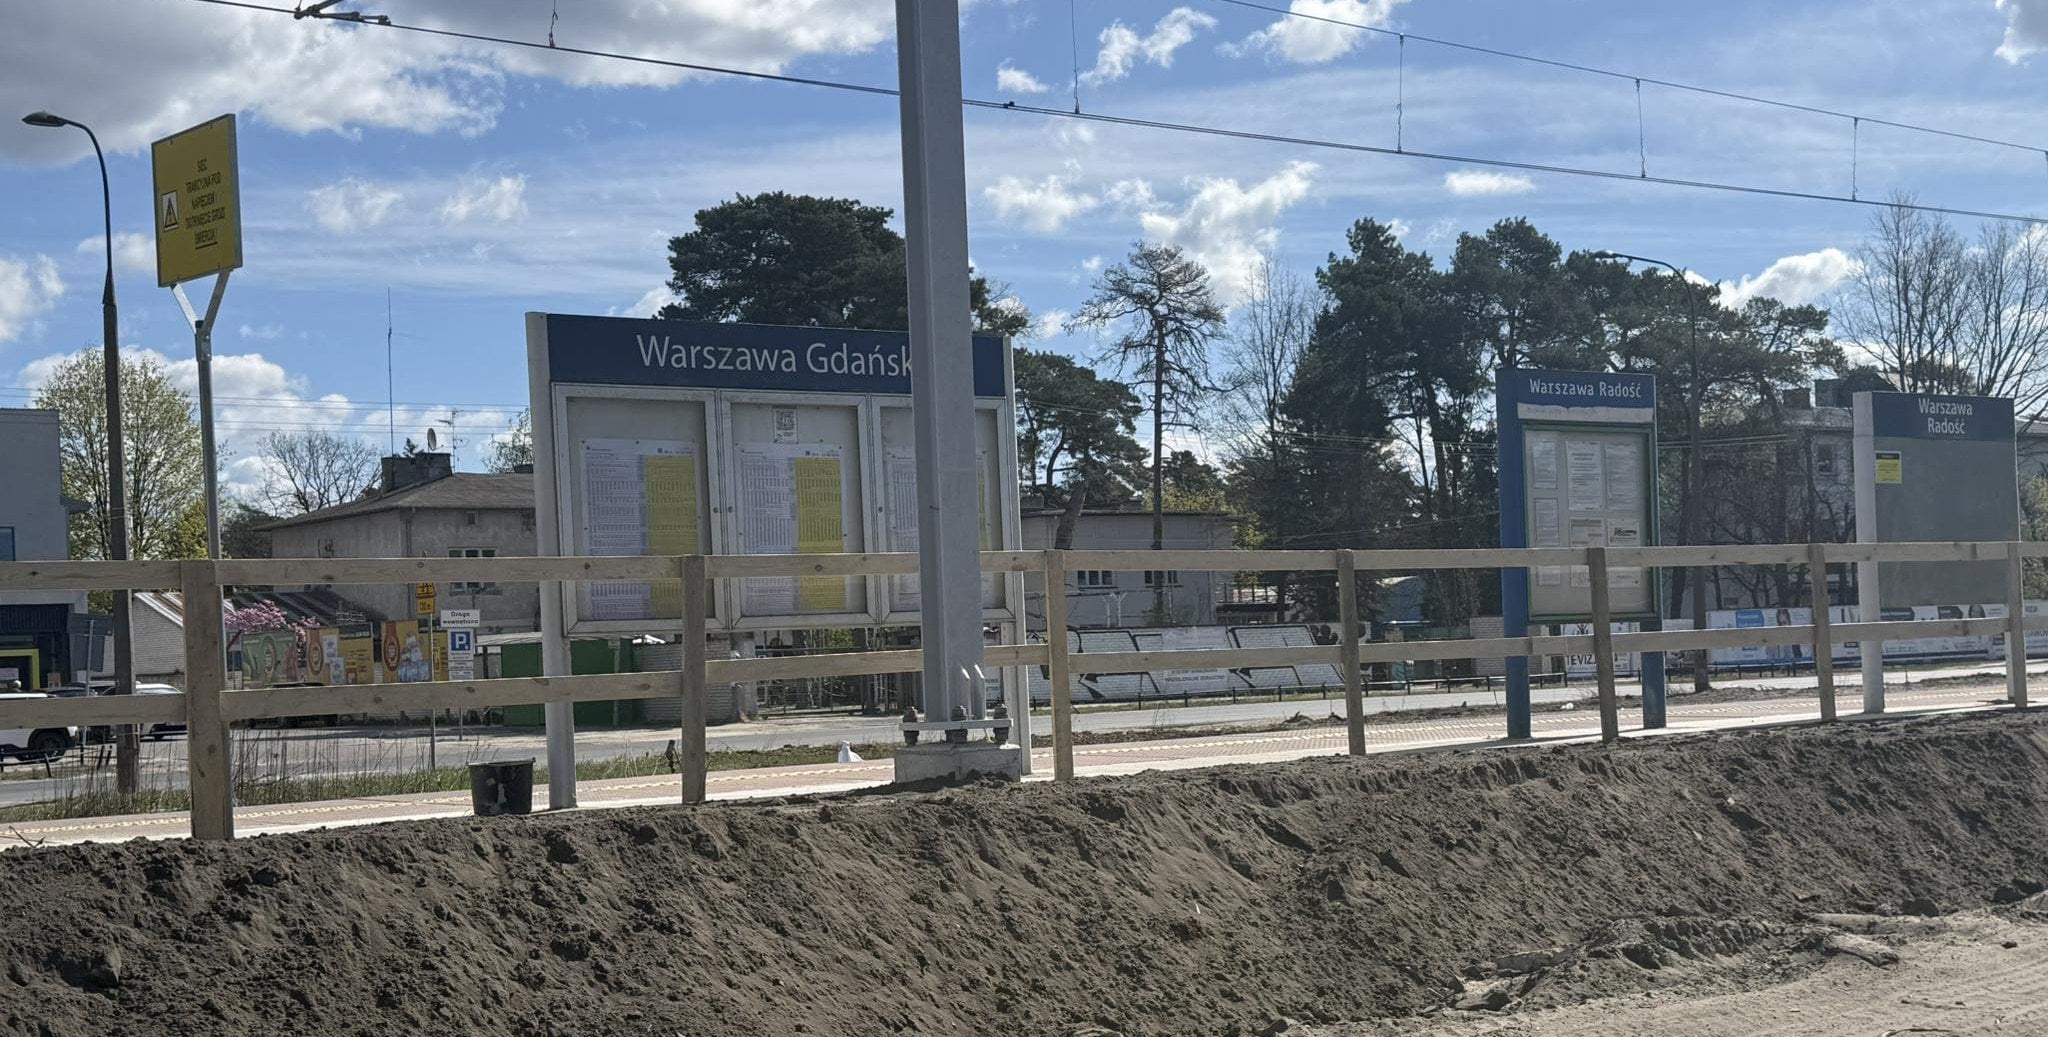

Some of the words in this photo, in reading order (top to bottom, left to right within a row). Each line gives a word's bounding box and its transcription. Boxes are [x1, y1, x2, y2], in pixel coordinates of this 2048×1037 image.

[636, 334, 797, 373] Warszawa
[1529, 378, 1594, 396] Warszawa
[1600, 381, 1642, 398] Radość
[1918, 398, 1973, 416] Warszawa
[1927, 417, 1965, 434] Radość
